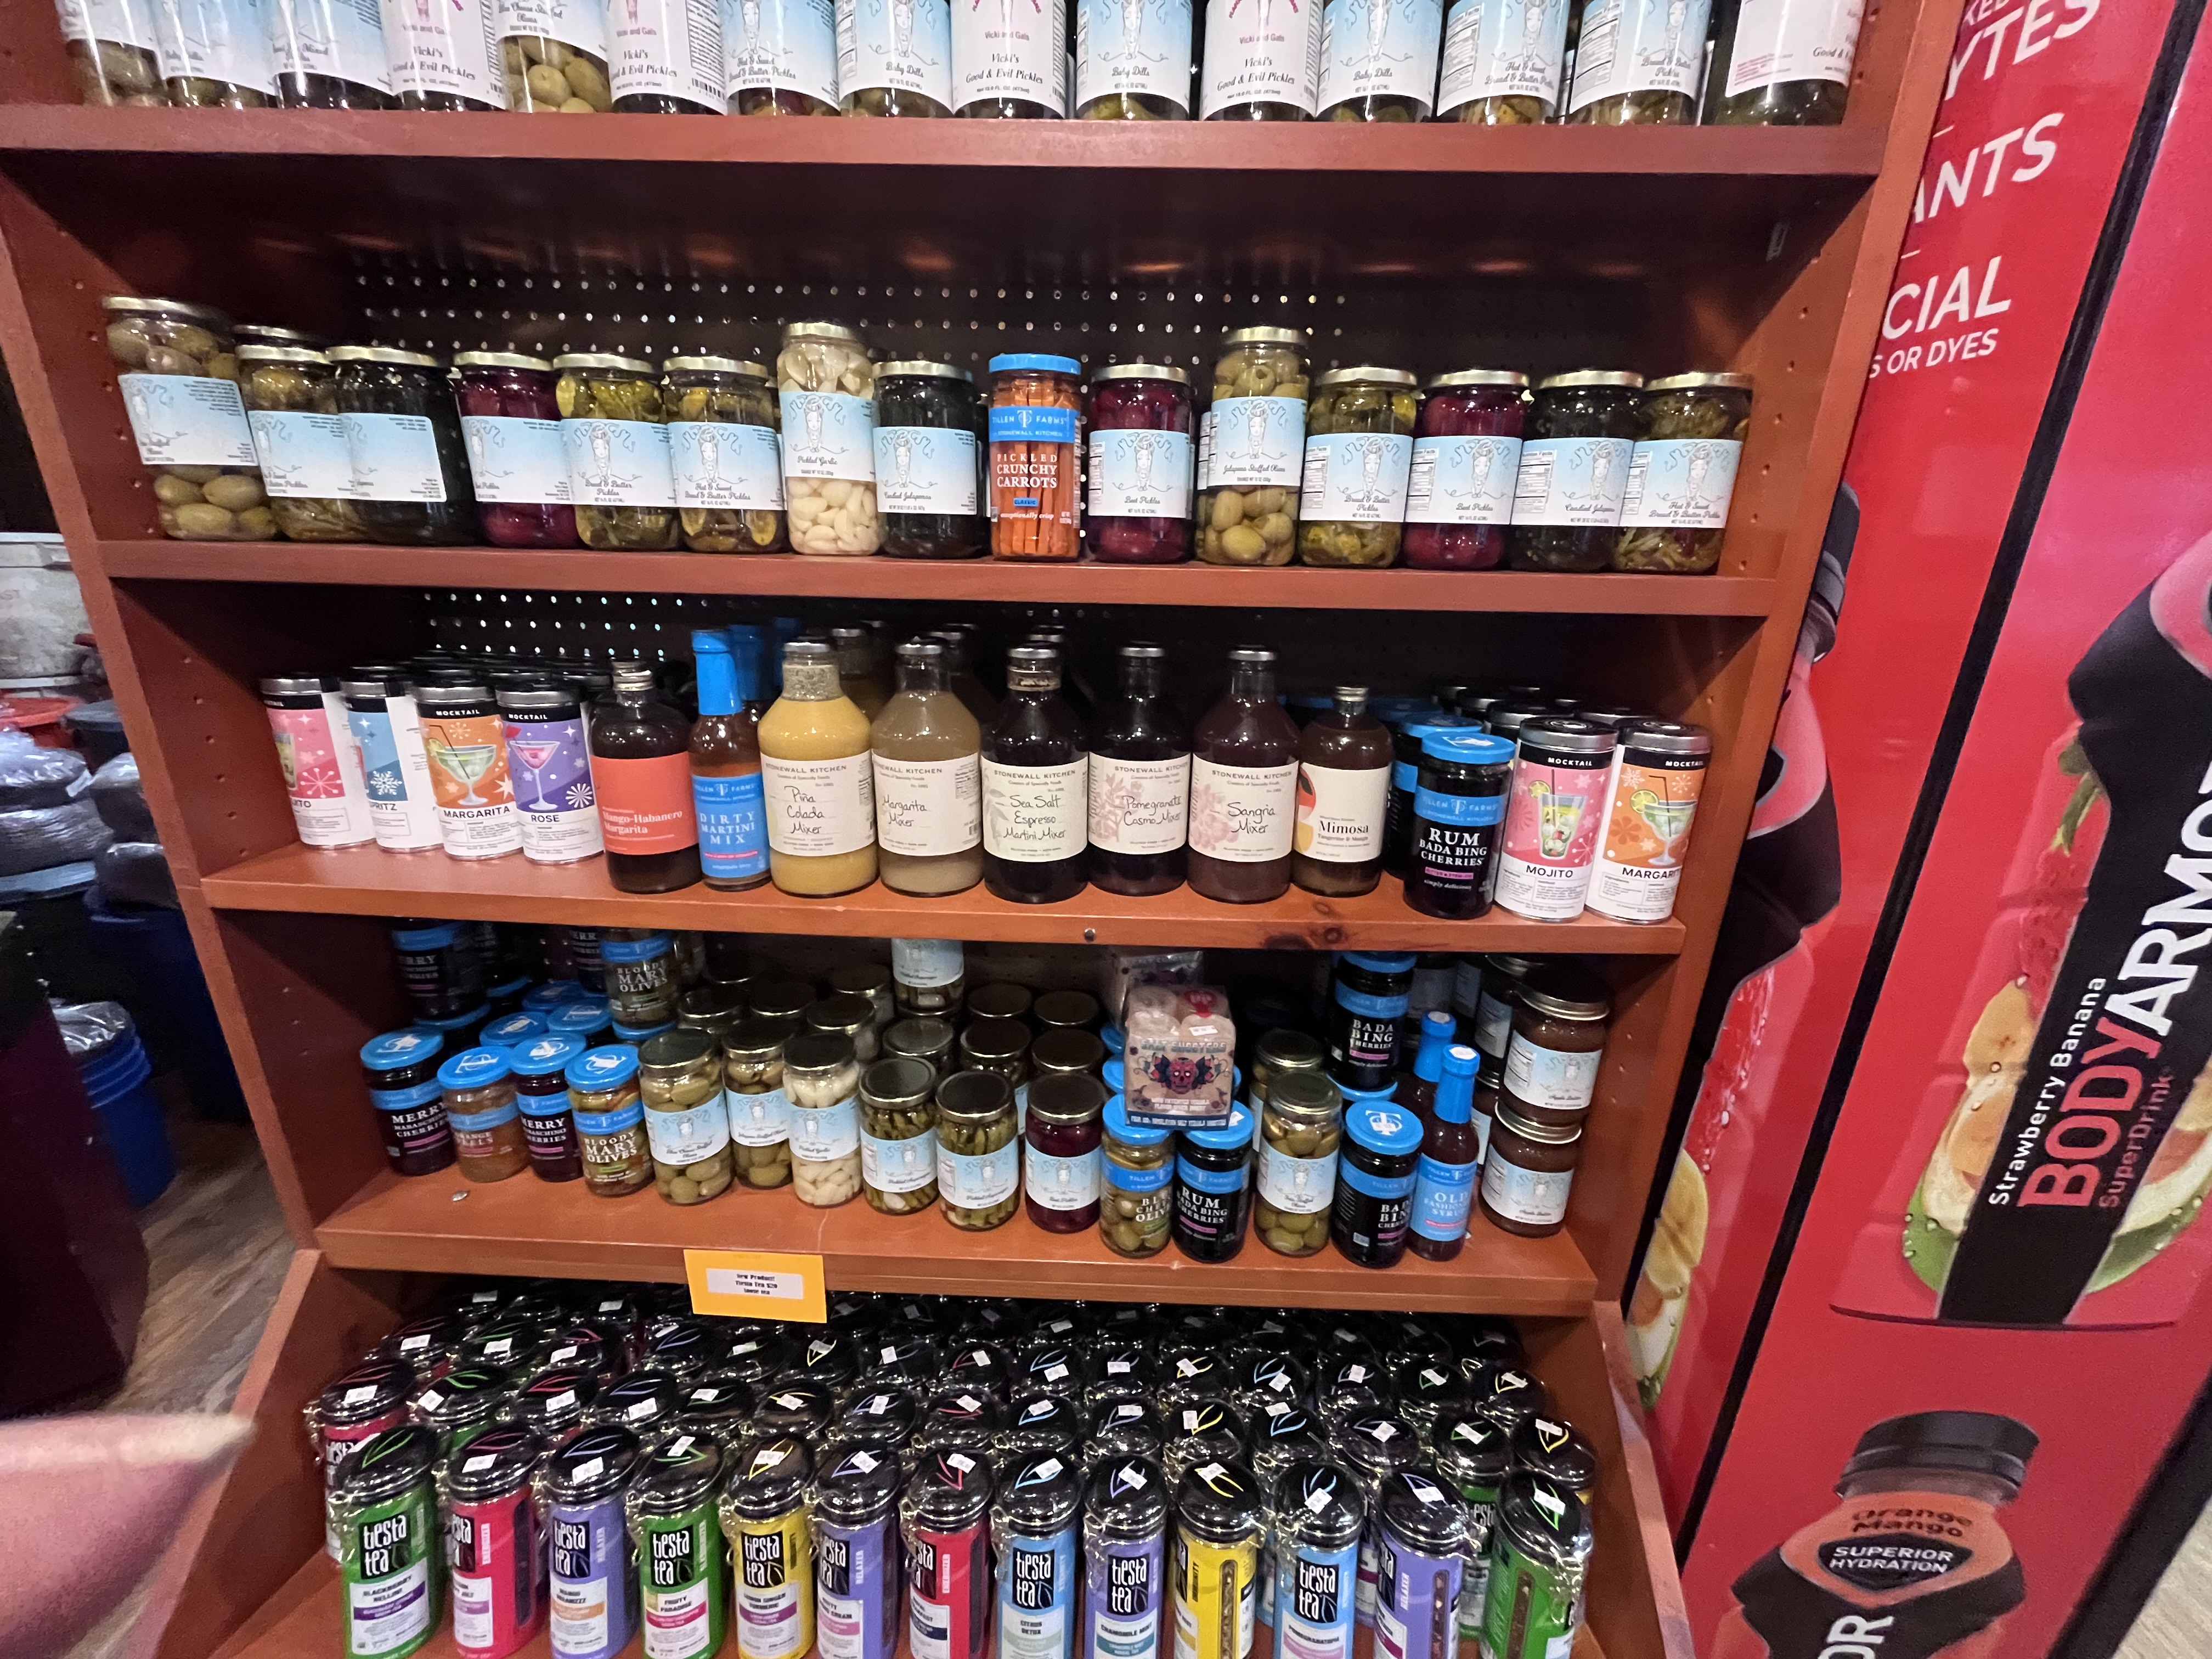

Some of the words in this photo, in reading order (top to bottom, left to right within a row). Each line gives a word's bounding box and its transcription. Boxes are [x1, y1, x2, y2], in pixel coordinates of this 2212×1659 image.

[1813, 47, 1835, 58] Good
[442, 64, 476, 80] Pickles
[646, 65, 677, 77] Pickles
[966, 70, 984, 83] Good
[986, 69, 992, 78] &
[996, 68, 1013, 78] Evil
[1016, 69, 1043, 84] Pickles
[1217, 76, 1235, 91] Good
[1238, 74, 1244, 85] &
[1248, 72, 1265, 83] Evil
[1268, 71, 1295, 85] Pickles
[1882, 256, 2011, 340] CIAL
[1887, 346, 1922, 373] OR
[1926, 328, 1999, 367] DYES
[997, 454, 1057, 462] PICKLED
[996, 464, 1057, 475] CRUNCHY
[997, 476, 1057, 488] CARROTS
[436, 708, 481, 716] MOCKTAIL
[809, 764, 847, 774] KITCHEN
[1548, 756, 1593, 767] MOCKTAIL
[994, 770, 1041, 780] STONEWALL
[1043, 769, 1076, 779] KITCHEN
[1211, 769, 1261, 780] STONEWALL
[1264, 771, 1292, 780] KITCHEN
[784, 785, 816, 804] Piña
[1009, 794, 1031, 809] Sea
[1034, 795, 1061, 809] Salt
[443, 805, 511, 820] MARGARITA
[786, 805, 825, 819] Colada
[881, 794, 927, 816] Margarita
[1227, 802, 1276, 824] Sangria
[530, 814, 561, 823] ROSE
[602, 810, 682, 825] Mango-Habanero
[699, 811, 755, 825] DIRTY
[1014, 810, 1057, 826] Espresso
[604, 821, 648, 836] Margarita
[701, 822, 755, 834] MARTINI
[790, 822, 822, 835] Mixer
[1003, 827, 1037, 840] Martini
[1037, 828, 1066, 841] Mixer
[1231, 820, 1269, 835] Mixer
[1319, 820, 1368, 834] Mimosa
[709, 834, 746, 845] MIX
[1429, 827, 1480, 846] RUM
[1419, 838, 1452, 855] BADA
[1455, 847, 1487, 856] BING
[1421, 850, 1485, 866] CHERRIES
[1525, 864, 1574, 879] MOJITO
[618, 968, 665, 984] MARY
[2017, 758, 2212, 1208] BODYARMO
[619, 977, 667, 992] OLIVES
[1353, 1019, 1393, 1032] BADA
[1351, 1028, 1393, 1042] BING
[1988, 1075, 2067, 1206] Strawberry
[2049, 977, 2107, 1068] Banana
[391, 1102, 446, 1124] MERRY
[522, 1117, 566, 1129] MERRY
[584, 1130, 635, 1146] BLOODY
[586, 1136, 636, 1155] MARY
[2098, 1073, 2175, 1208] SuperDrink
[588, 1147, 637, 1164] OLIVES
[1182, 1186, 1220, 1209] RUM
[1200, 1207, 1228, 1216] BING
[1852, 1508, 1974, 1528] Orange
[363, 1514, 407, 1550] tiesta
[554, 1521, 586, 1550] tiesta
[1852, 1519, 1964, 1538] Mango
[652, 1530, 690, 1559] tiesta
[744, 1535, 780, 1561] tiesta
[555, 1548, 571, 1576] tea
[1833, 1546, 1955, 1562] SUPERIOR
[365, 1549, 390, 1577] tea
[1016, 1551, 1051, 1581] tiesta
[1829, 1559, 1948, 1574] HYDRATION
[654, 1559, 674, 1585] tea
[746, 1561, 765, 1587] tea
[1111, 1558, 1147, 1586] tiesta
[1300, 1561, 1336, 1594] tiesta
[1016, 1579, 1035, 1607] tea
[1112, 1586, 1131, 1613] tea
[1299, 1589, 1319, 1620] tea
